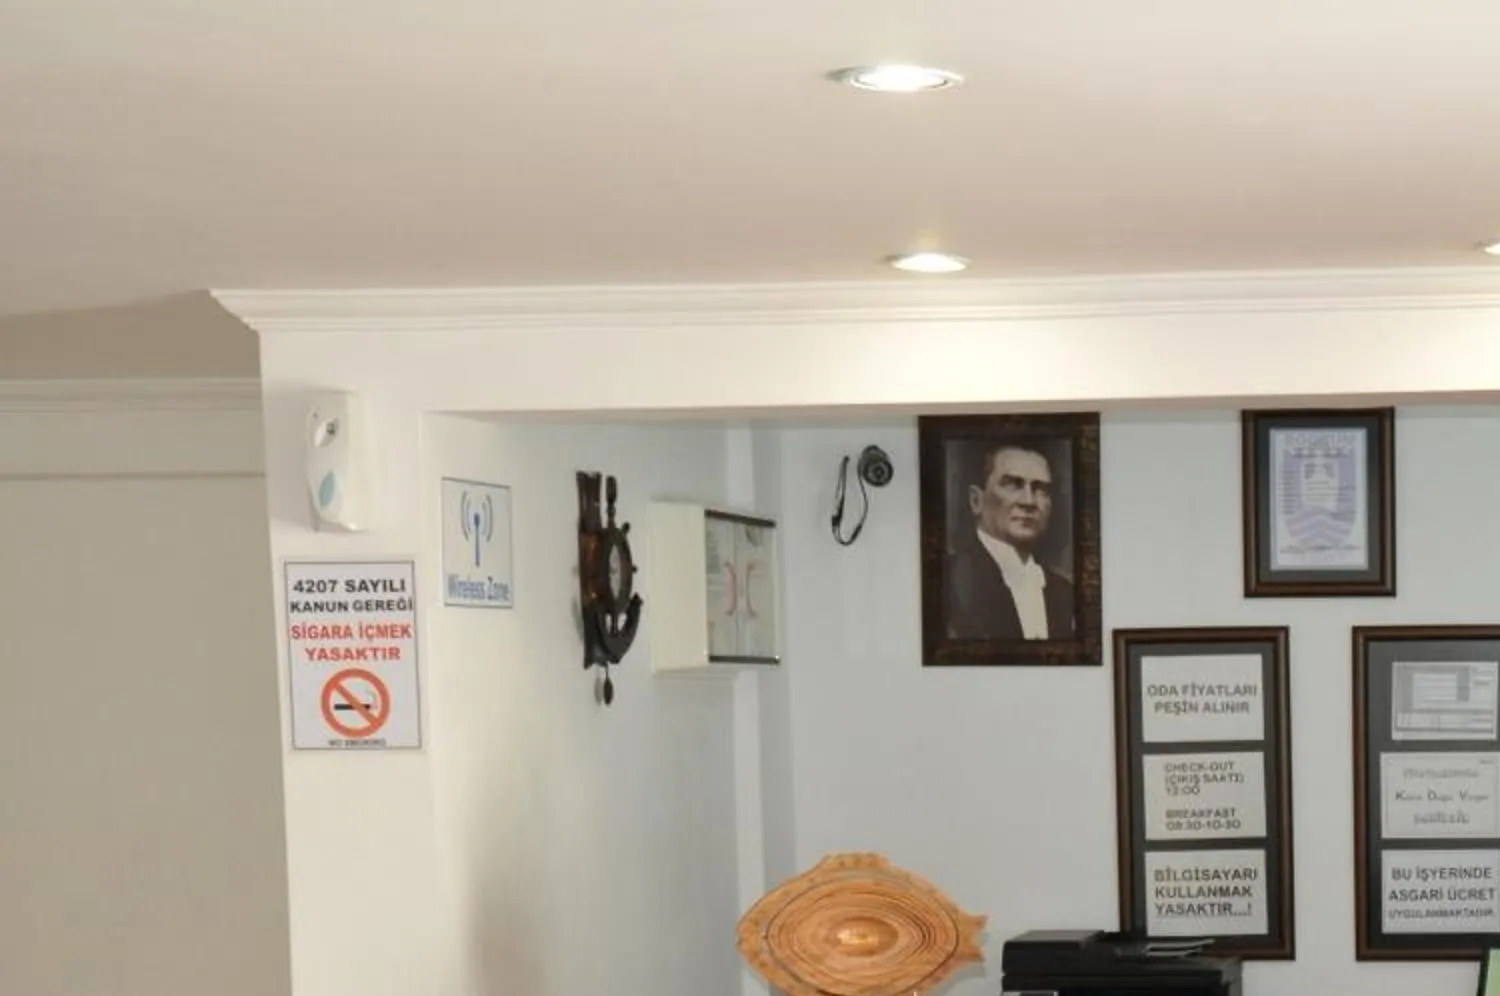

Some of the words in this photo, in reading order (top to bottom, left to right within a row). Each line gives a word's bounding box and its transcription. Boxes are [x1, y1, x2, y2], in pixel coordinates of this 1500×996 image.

[293, 579, 337, 593] 4207
[345, 578, 405, 592] SAYILI
[290, 600, 348, 613] KANUN
[352, 597, 413, 612] GEREĞİ
[290, 622, 353, 640] SİGARA
[359, 621, 412, 641] İÇMEK
[305, 647, 400, 661] YASAKTIR
[1147, 685, 1178, 697] ODA
[1182, 682, 1257, 697] FİYATLARI
[1154, 701, 1198, 716] PEŞİN
[1202, 701, 1250, 713] ALINIR
[1154, 867, 1258, 882] BİLGİSAYARI
[1391, 867, 1411, 880] BU
[1417, 865, 1492, 881] İŞYERİNDE
[1155, 885, 1252, 899] KULLANMAK
[1388, 887, 1443, 901] ASGARİ
